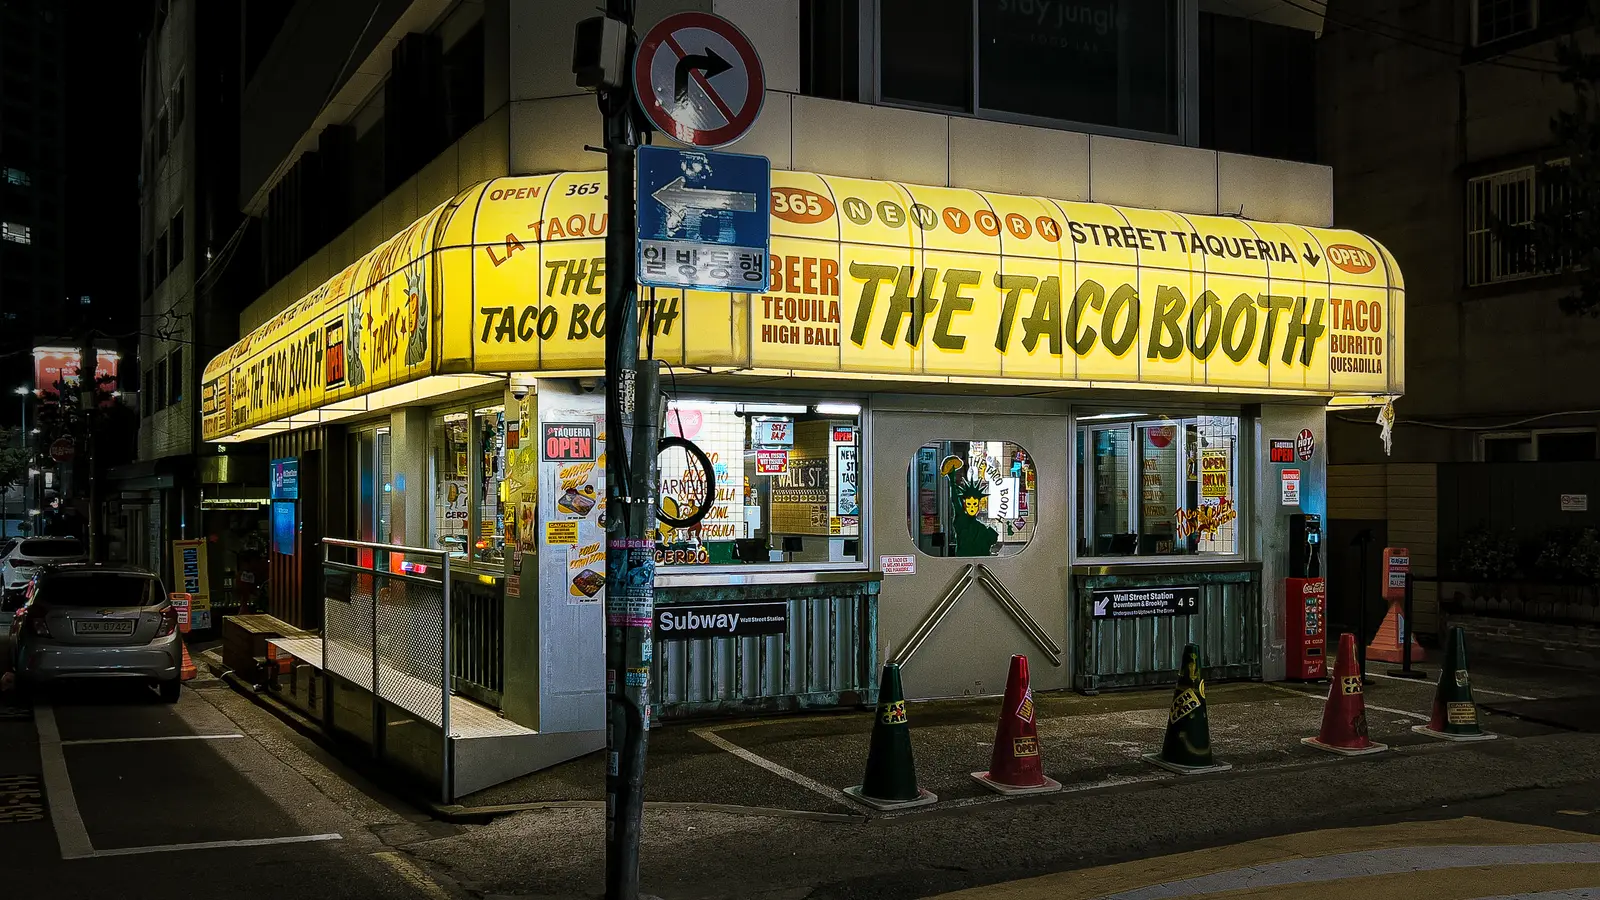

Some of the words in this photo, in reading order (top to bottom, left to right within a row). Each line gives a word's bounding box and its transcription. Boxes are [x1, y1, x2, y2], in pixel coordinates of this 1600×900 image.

[489, 187, 541, 201] OPEN
[565, 183, 600, 196] 365
[771, 192, 823, 216] 365
[486, 233, 526, 268] LA
[528, 213, 607, 242] TAQU
[847, 200, 936, 228] NEW
[946, 208, 1059, 239] YORK
[1069, 221, 1175, 252] STREET
[1171, 231, 1298, 264] TAQUERIA
[1328, 246, 1373, 267] OPEN
[545, 257, 606, 298] THE
[770, 255, 839, 295] BEER
[481, 303, 559, 344] TACO
[567, 297, 679, 341] BOTH
[762, 297, 840, 324] TEQUILA
[849, 260, 981, 351] THE
[993, 271, 1141, 357] TACO
[1146, 283, 1326, 367] BOOTH
[1331, 299, 1381, 332] TACO
[373, 307, 400, 374] TACOS
[762, 324, 801, 344] HIGH
[804, 327, 840, 347] BALL
[1331, 334, 1382, 356] BURRITO
[1331, 356, 1382, 374] QUESADILLA
[554, 427, 590, 438] TAQUERIA
[546, 437, 591, 459] OPEN
[1271, 448, 1293, 462] OPEN
[658, 479, 693, 494] ARNE
[778, 468, 805, 488] WALL
[808, 467, 822, 487] ST
[445, 511, 468, 519] CERD
[994, 488, 1010, 523] BOOTH
[655, 550, 708, 564] CERDO
[1113, 594, 1129, 602] Wall
[1129, 593, 1150, 601] Street
[1150, 592, 1174, 600] Station
[1113, 601, 1141, 609] Downtown
[1145, 600, 1168, 608] Brooklyn
[1178, 598, 1184, 607] 4
[1189, 597, 1195, 607] 5
[659, 611, 740, 632] Subway
[1016, 743, 1037, 754] OPEN
